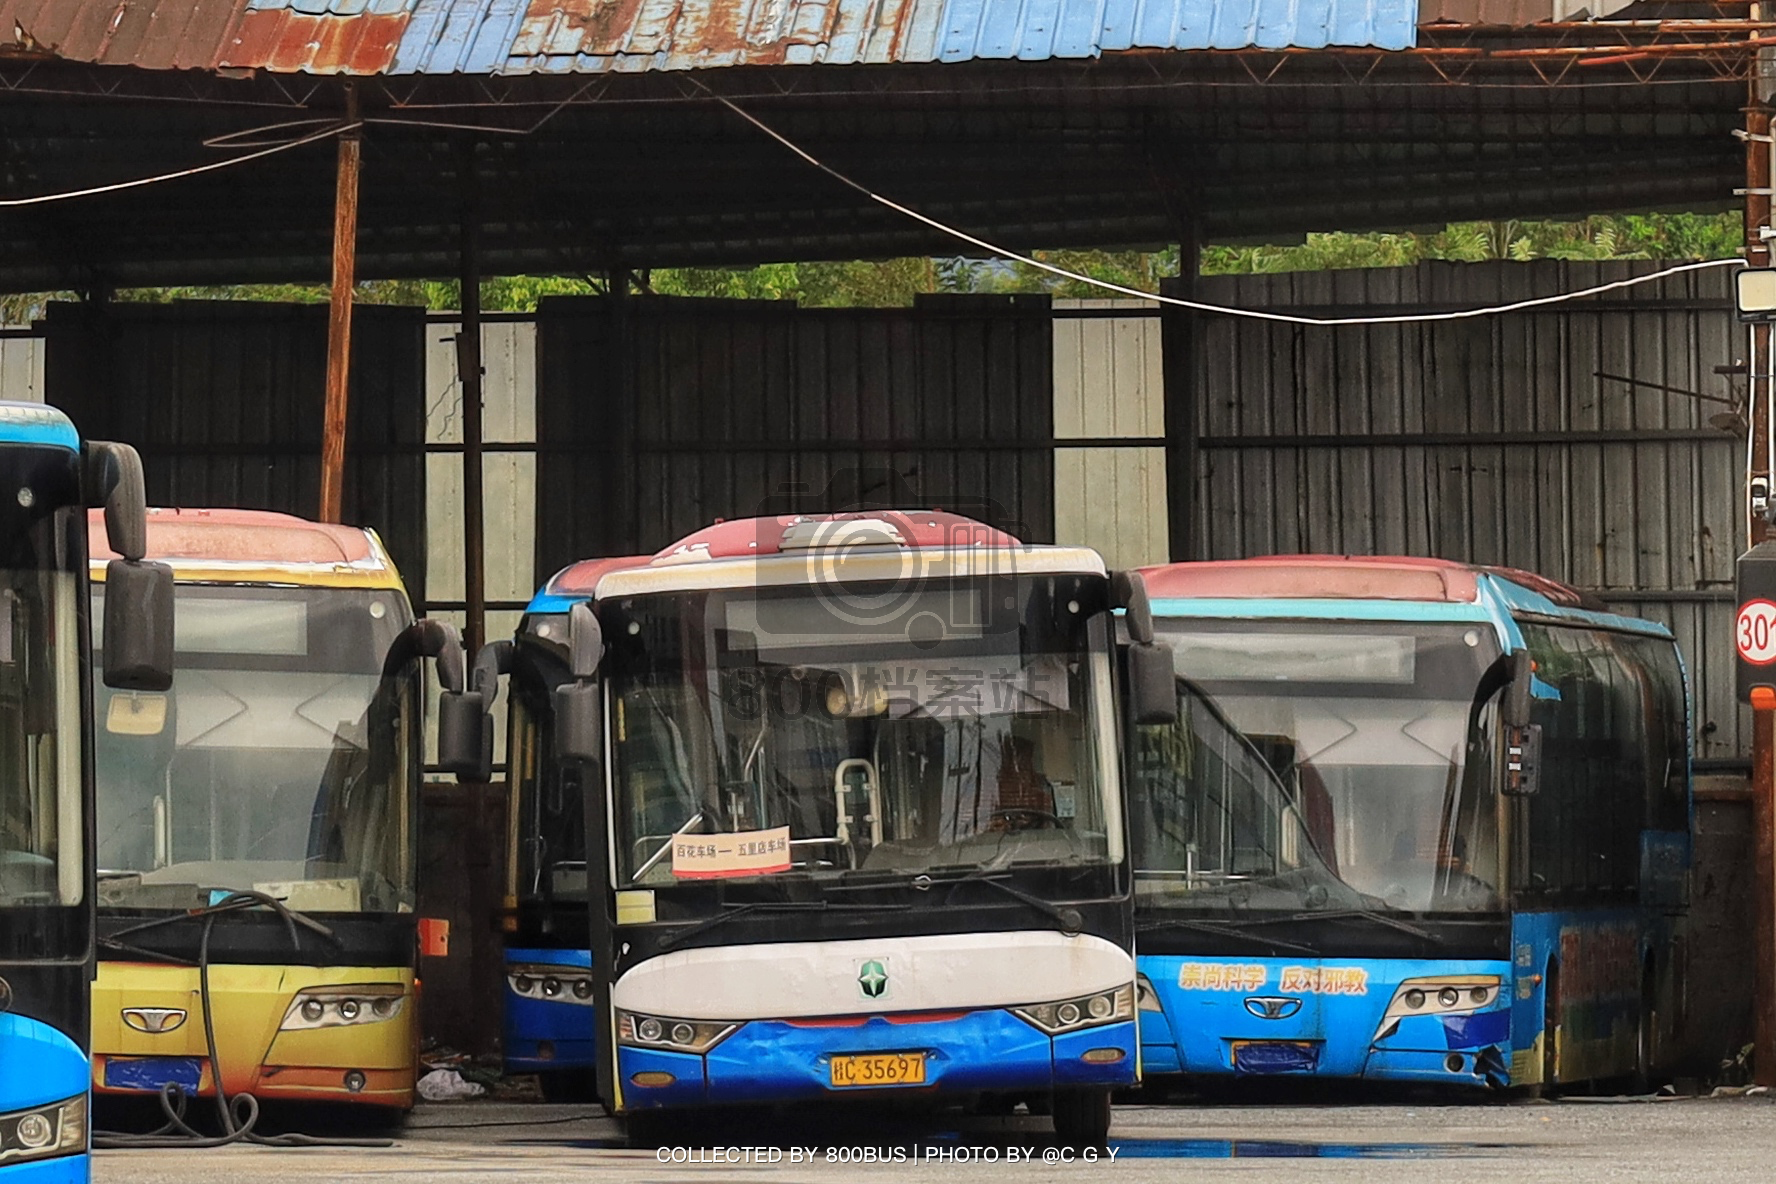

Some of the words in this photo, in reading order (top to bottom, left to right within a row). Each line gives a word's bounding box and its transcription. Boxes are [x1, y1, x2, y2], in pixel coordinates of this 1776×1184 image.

[676, 844, 716, 858] 百花车场
[1180, 963, 1266, 989] 崇尚科学
[1279, 967, 1367, 993] 反对邪教
